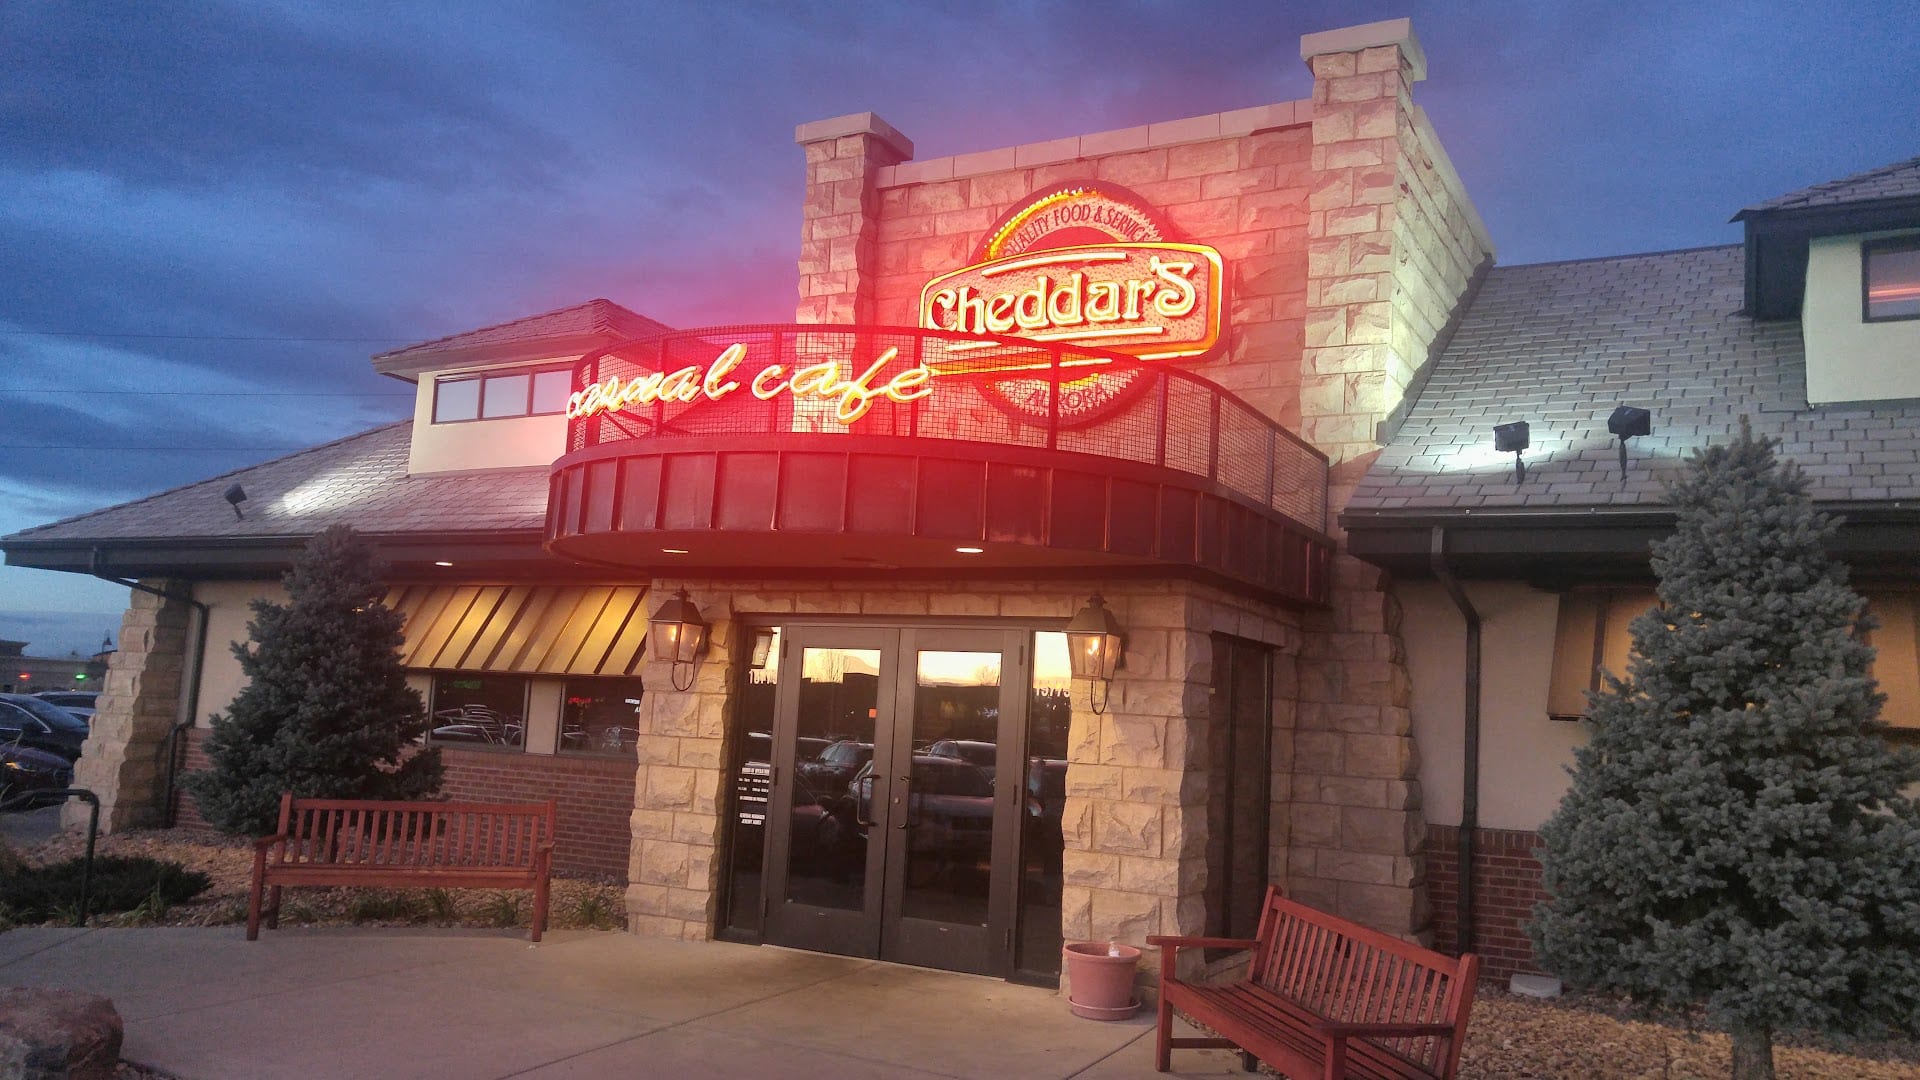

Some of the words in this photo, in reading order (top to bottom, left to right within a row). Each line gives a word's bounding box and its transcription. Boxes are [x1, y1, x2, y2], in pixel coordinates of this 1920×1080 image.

[1053, 203, 1091, 226] FOOD
[1093, 205, 1103, 222] &
[565, 343, 747, 420] casual
[751, 346, 933, 424] cafe
